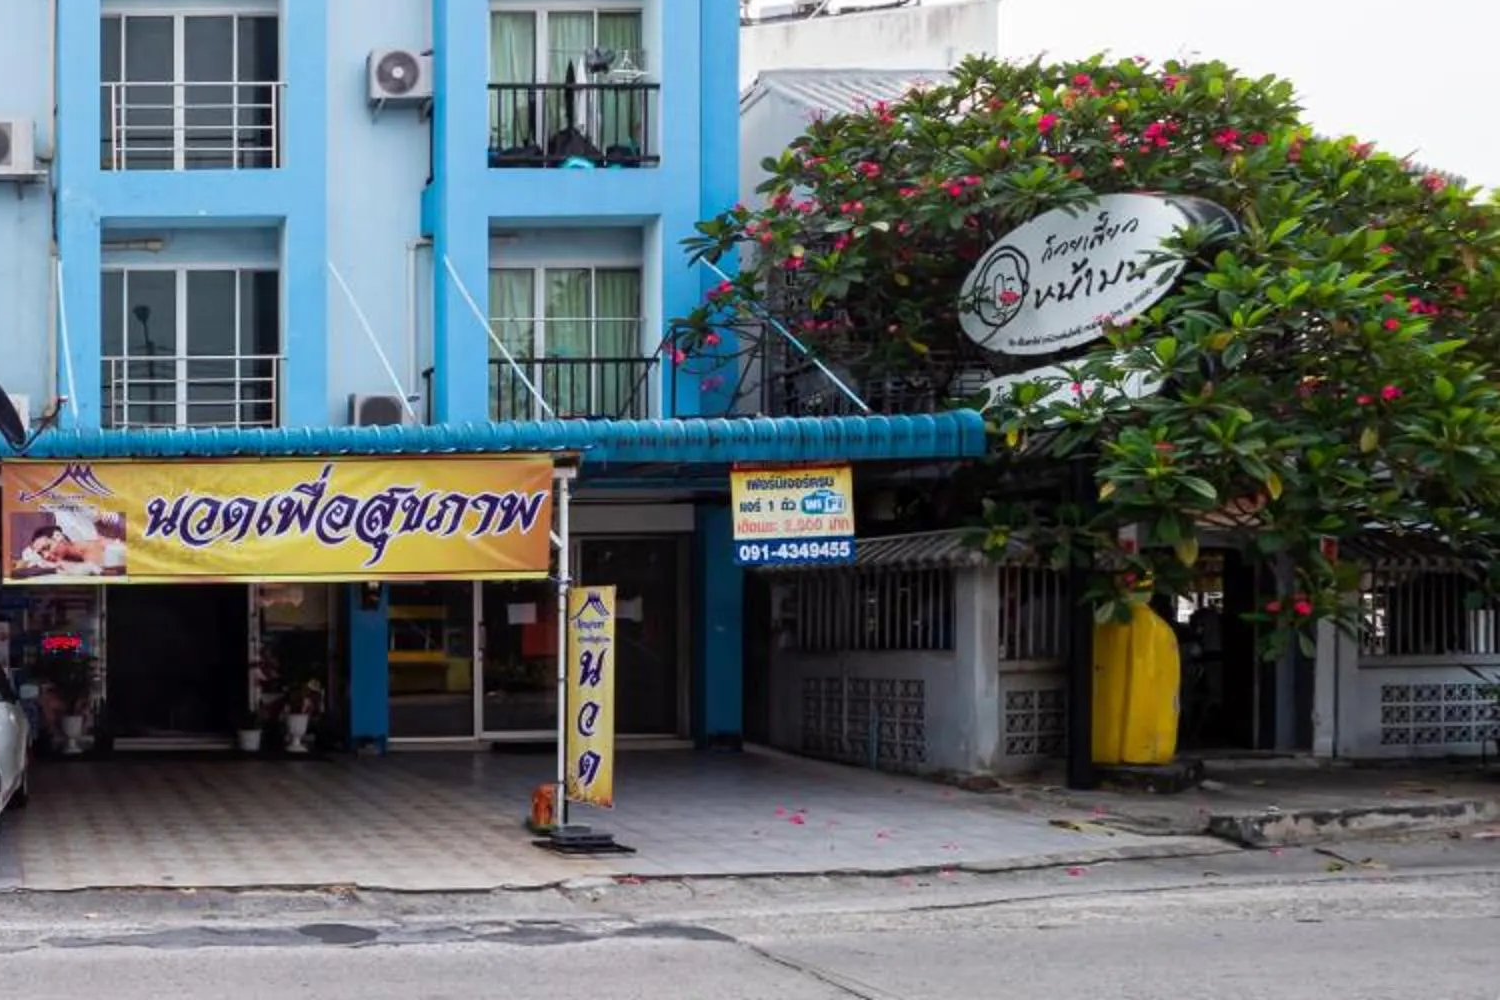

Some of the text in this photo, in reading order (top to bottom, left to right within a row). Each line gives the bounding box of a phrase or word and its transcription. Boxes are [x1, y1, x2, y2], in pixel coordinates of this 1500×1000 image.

[146, 463, 548, 567] นวดเพื่อสุขภาพ
[768, 500, 775, 511] 1
[739, 541, 851, 561] 091-4349455
